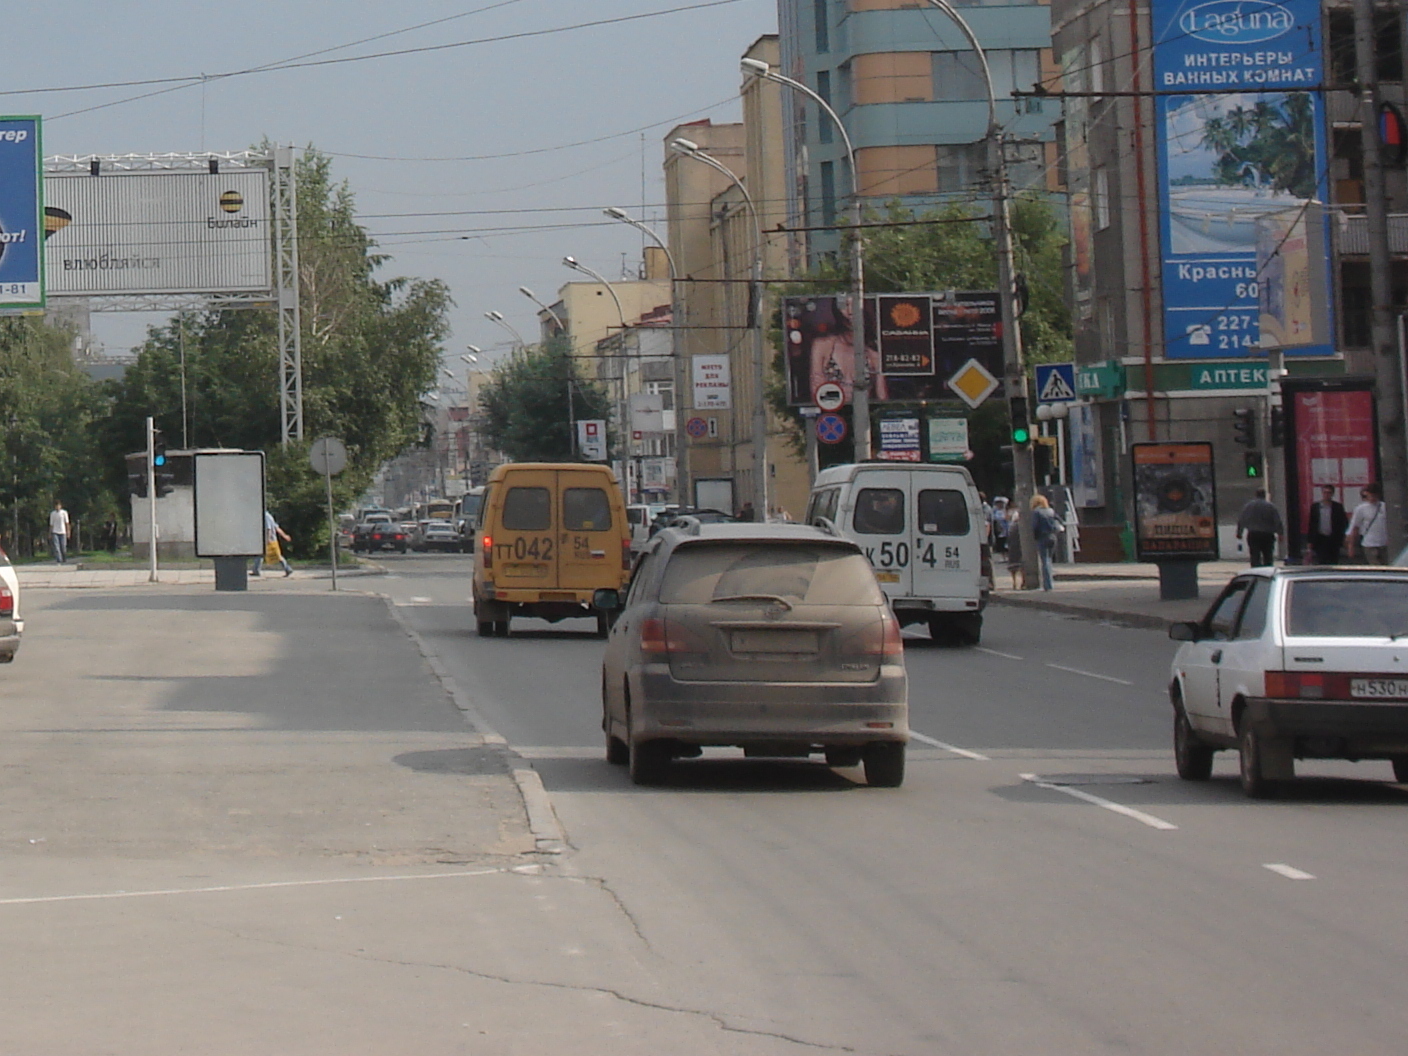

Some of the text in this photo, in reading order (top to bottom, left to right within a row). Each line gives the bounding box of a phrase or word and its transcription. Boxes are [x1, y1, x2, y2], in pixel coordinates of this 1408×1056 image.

[1189, 1, 1291, 37] Laguna
[1184, 51, 1293, 68] ИНТЕРЬЕРЫ
[1163, 68, 1315, 86] ВАННЫХ КОМНАТ
[207, 216, 258, 230] Билайн
[1200, 368, 1269, 385] АПТЕК
[573, 535, 589, 550] 54
[944, 546, 960, 559] 54
